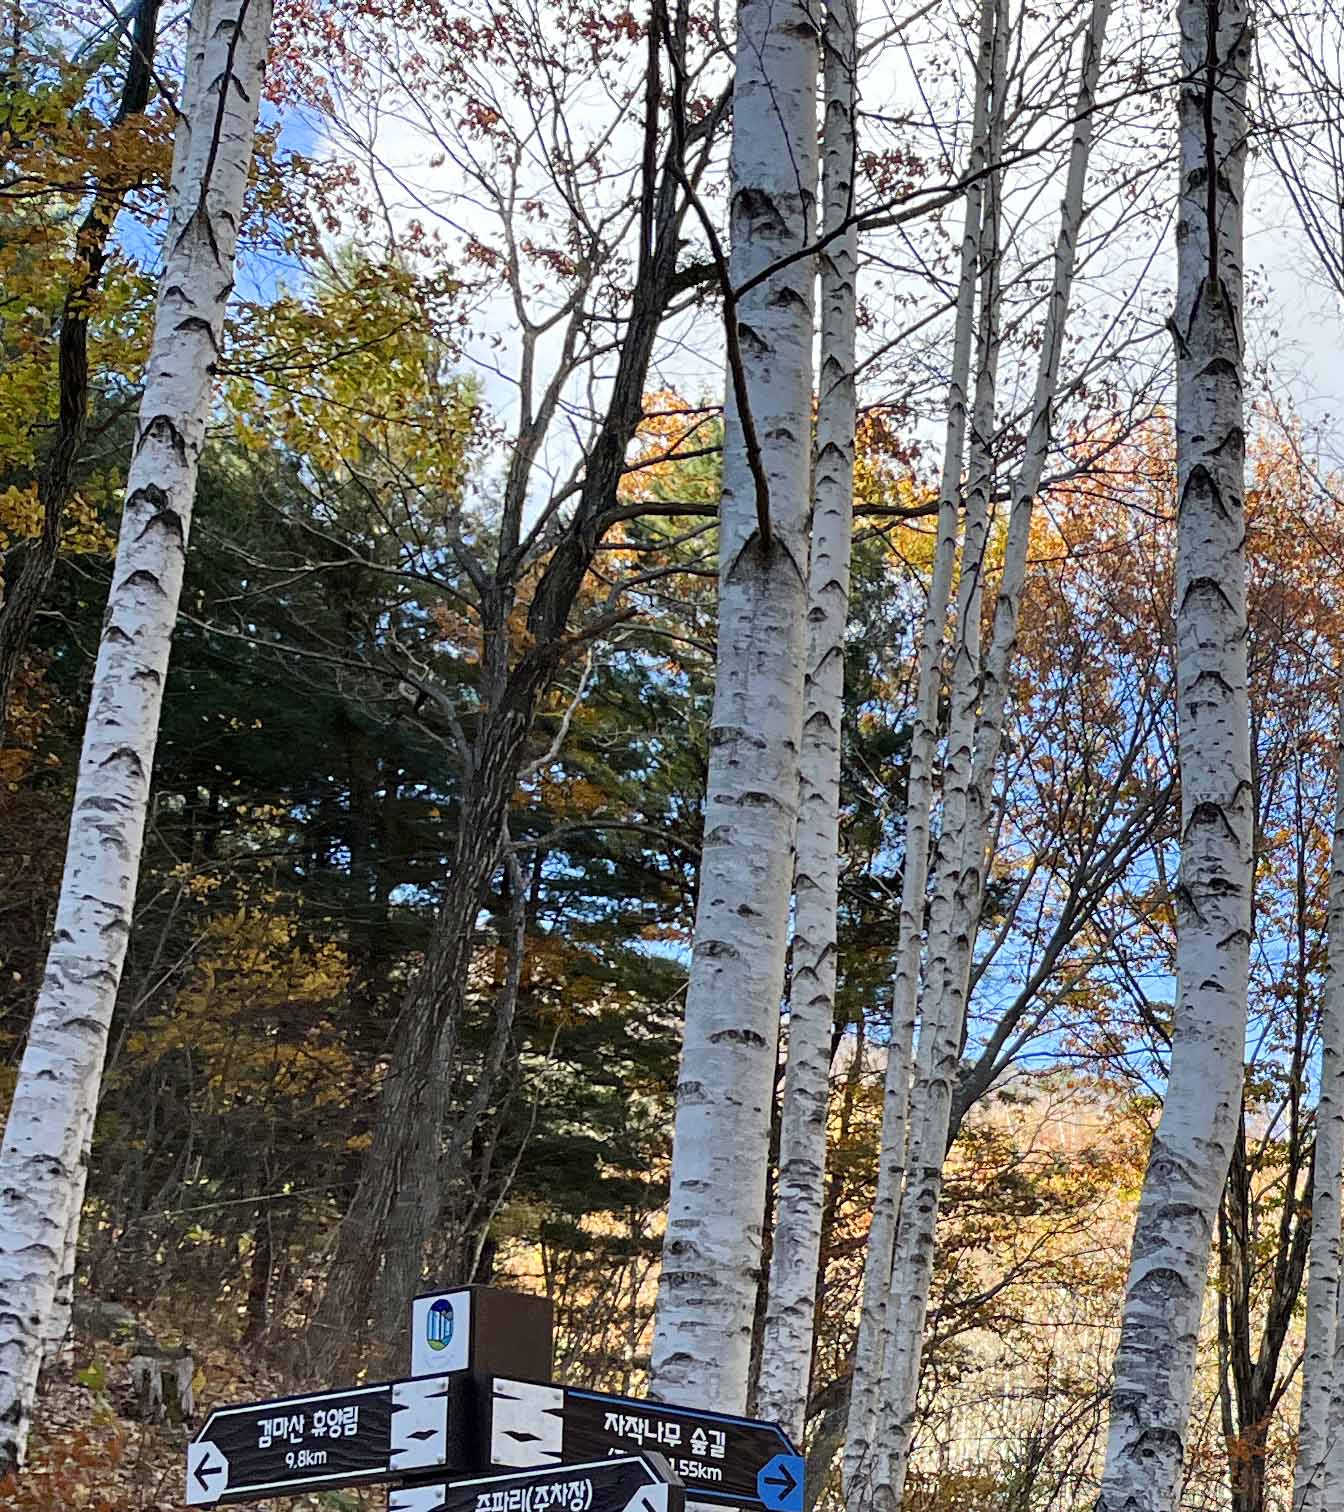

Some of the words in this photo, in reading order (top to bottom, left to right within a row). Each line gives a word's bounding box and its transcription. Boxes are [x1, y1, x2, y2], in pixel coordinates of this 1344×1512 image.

[257, 1414, 305, 1449] 검마산
[312, 1405, 360, 1438] 휴양림
[604, 1412, 682, 1448] 자작나무
[691, 1427, 726, 1458] 숲길
[285, 1450, 327, 1469] 9.8km
